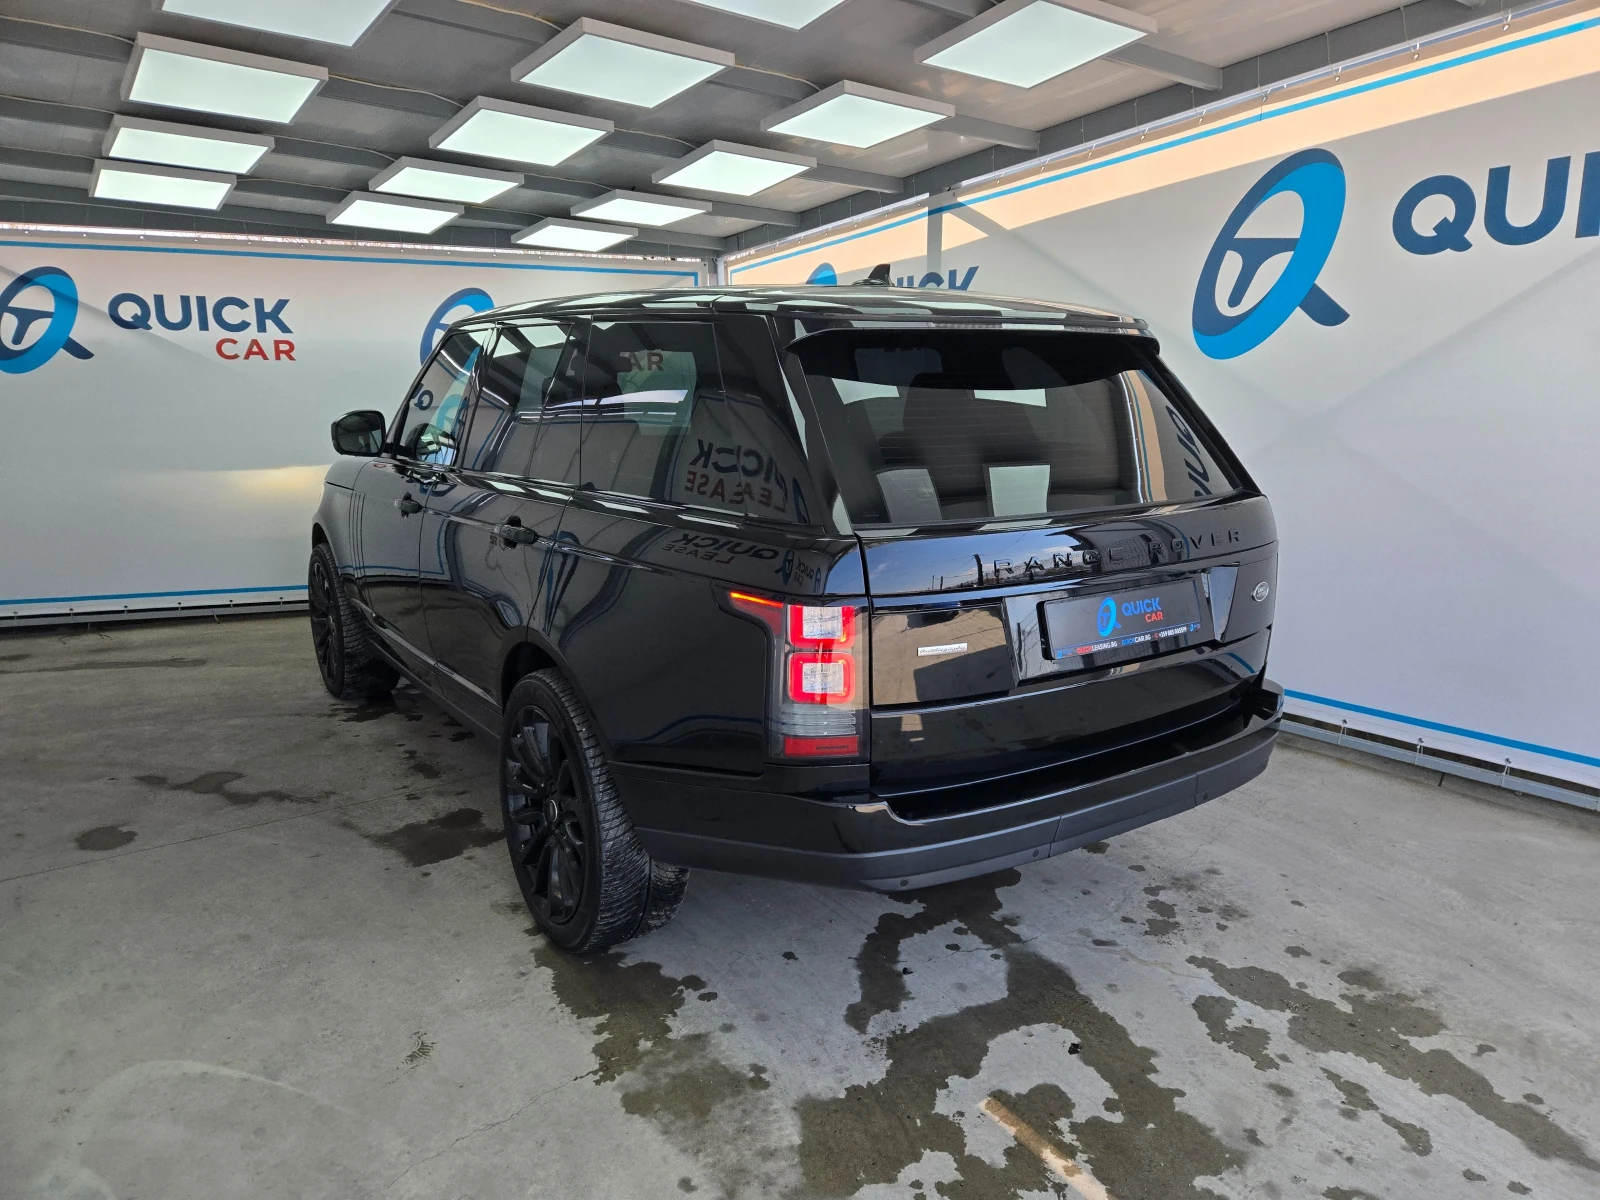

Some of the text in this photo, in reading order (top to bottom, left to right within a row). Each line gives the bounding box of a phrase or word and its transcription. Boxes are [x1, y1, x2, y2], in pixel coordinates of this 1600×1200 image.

[107, 292, 295, 334] QUICK
[215, 337, 297, 362] CAR
[993, 529, 1240, 575] RANGE ROVER
[1121, 597, 1161, 616] QUICK
[1144, 612, 1164, 623] CAR
